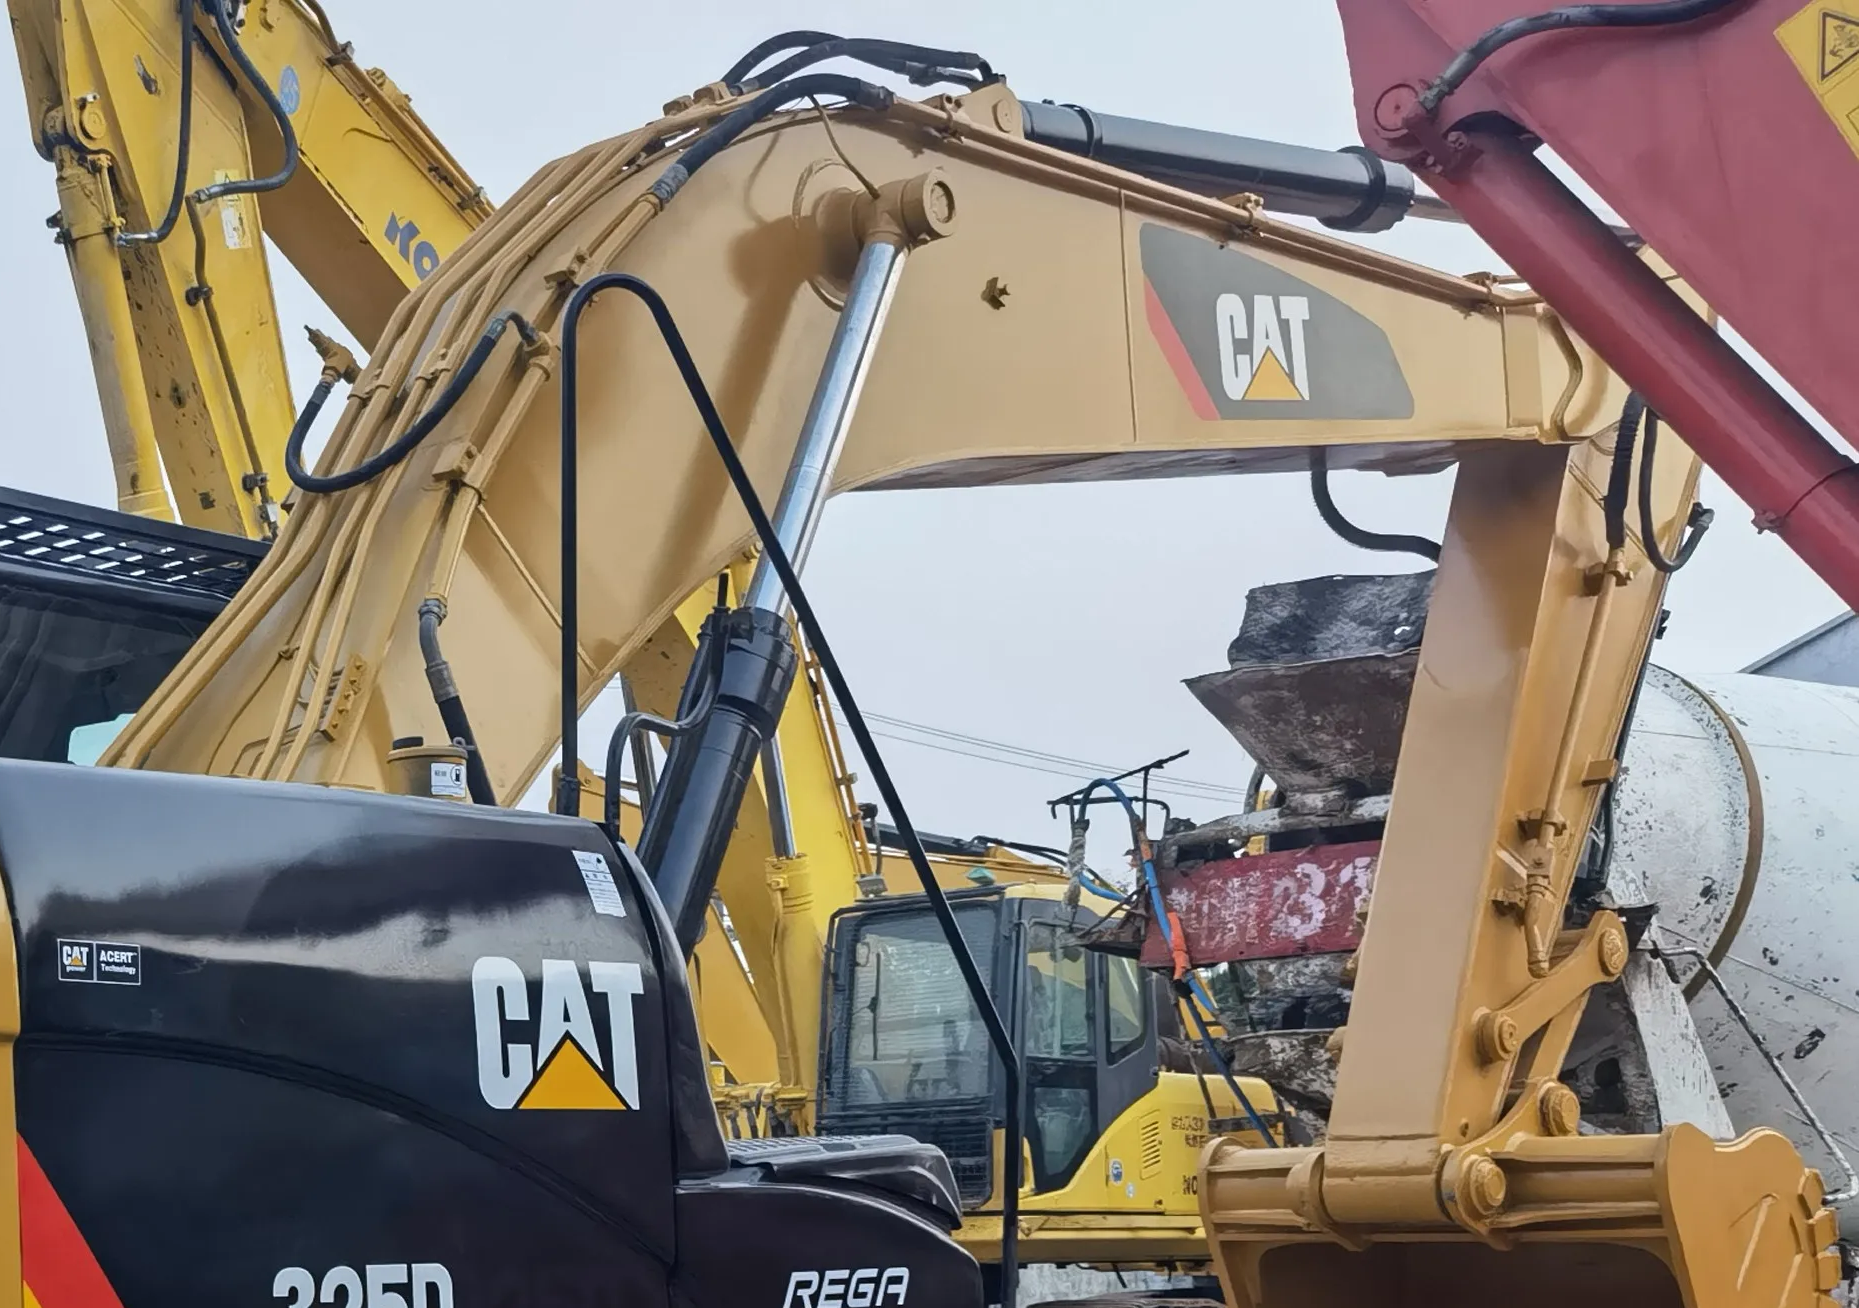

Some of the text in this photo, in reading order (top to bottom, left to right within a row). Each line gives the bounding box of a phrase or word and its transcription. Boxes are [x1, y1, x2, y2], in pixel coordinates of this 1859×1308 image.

[1216, 293, 1310, 401] CAT
[62, 945, 89, 966] CAT
[99, 950, 133, 963] ACERT
[472, 956, 644, 1110] CAT
